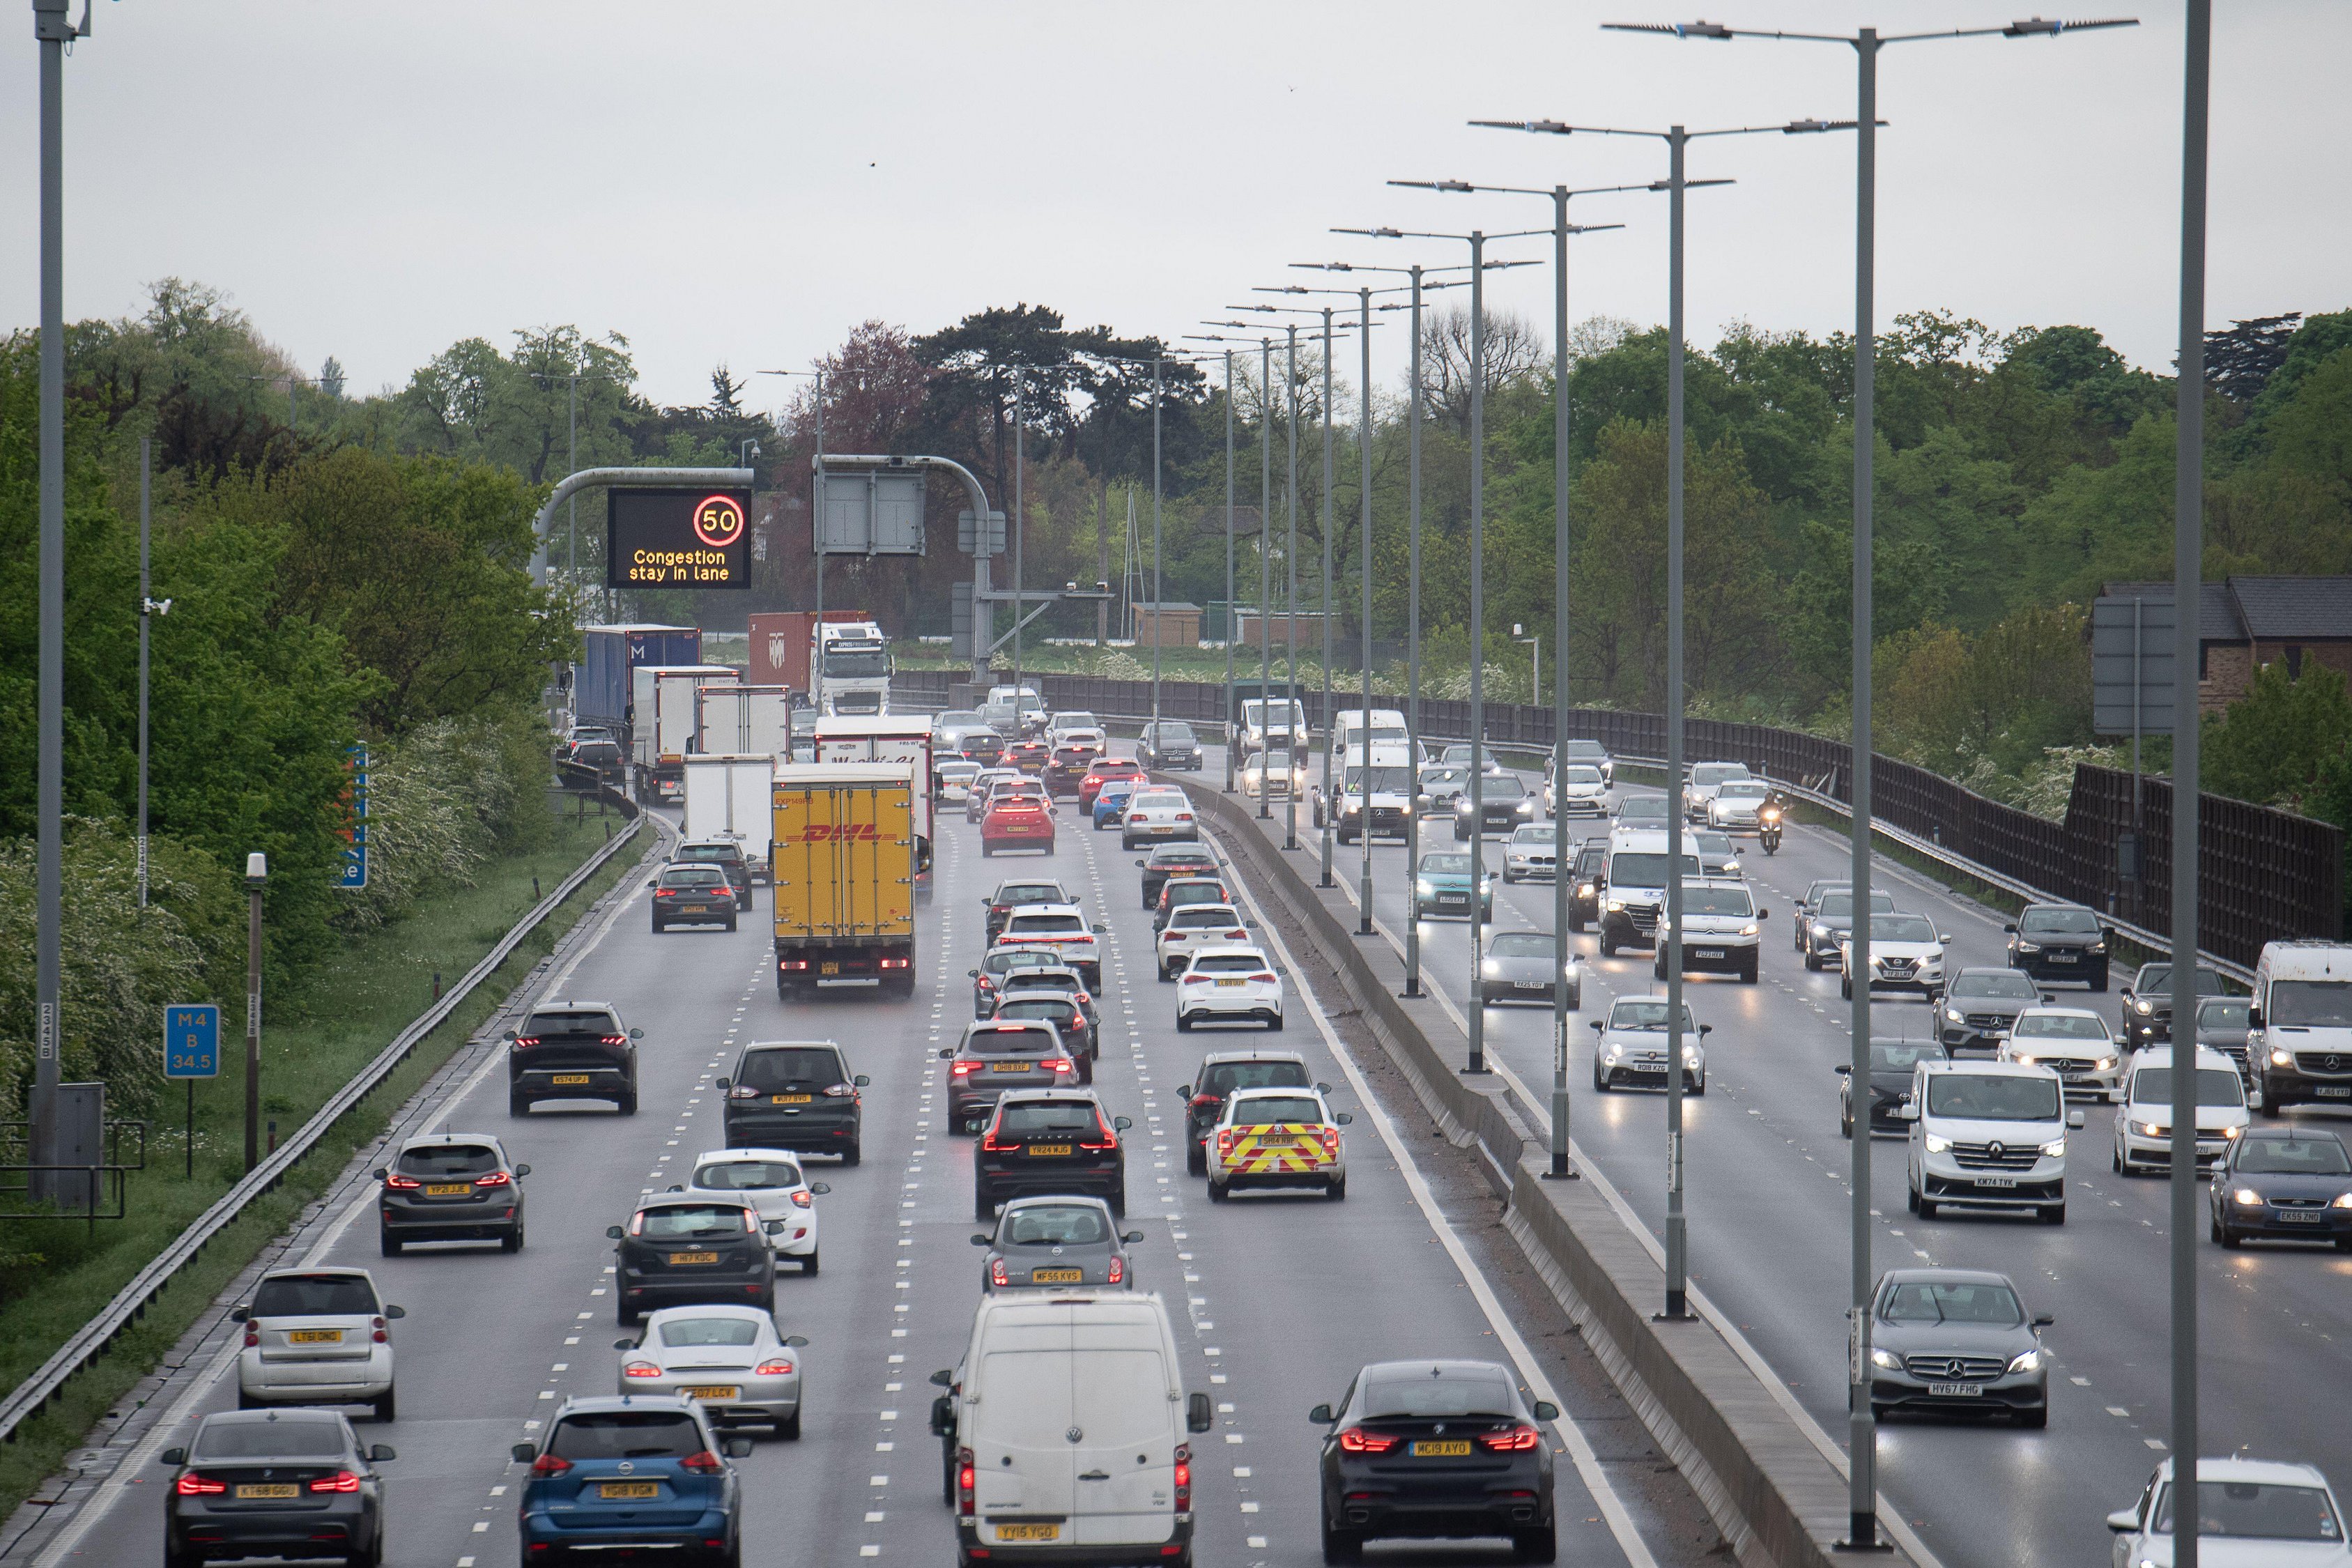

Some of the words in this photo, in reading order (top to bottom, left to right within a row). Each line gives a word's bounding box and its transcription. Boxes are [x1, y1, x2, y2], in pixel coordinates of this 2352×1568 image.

[703, 511, 736, 532] 50
[634, 549, 725, 566] Congestion
[629, 565, 666, 583] stay
[673, 565, 686, 581] in
[694, 565, 729, 581] lane
[631, 646, 645, 659] M
[801, 824, 882, 841] DHL
[178, 1013, 207, 1027] M4
[187, 1034, 198, 1047] B
[173, 1054, 211, 1068] 34.5
[1263, 1136, 1279, 1144] SH14
[1977, 1178, 1997, 1186] KM74
[1999, 1178, 2013, 1187] TVK
[1036, 1272, 1058, 1282] MF55
[1060, 1272, 1077, 1281] KVS
[1932, 1384, 1957, 1394] HV67
[1960, 1384, 1978, 1394] FHG
[1417, 1443, 1441, 1454] MC19
